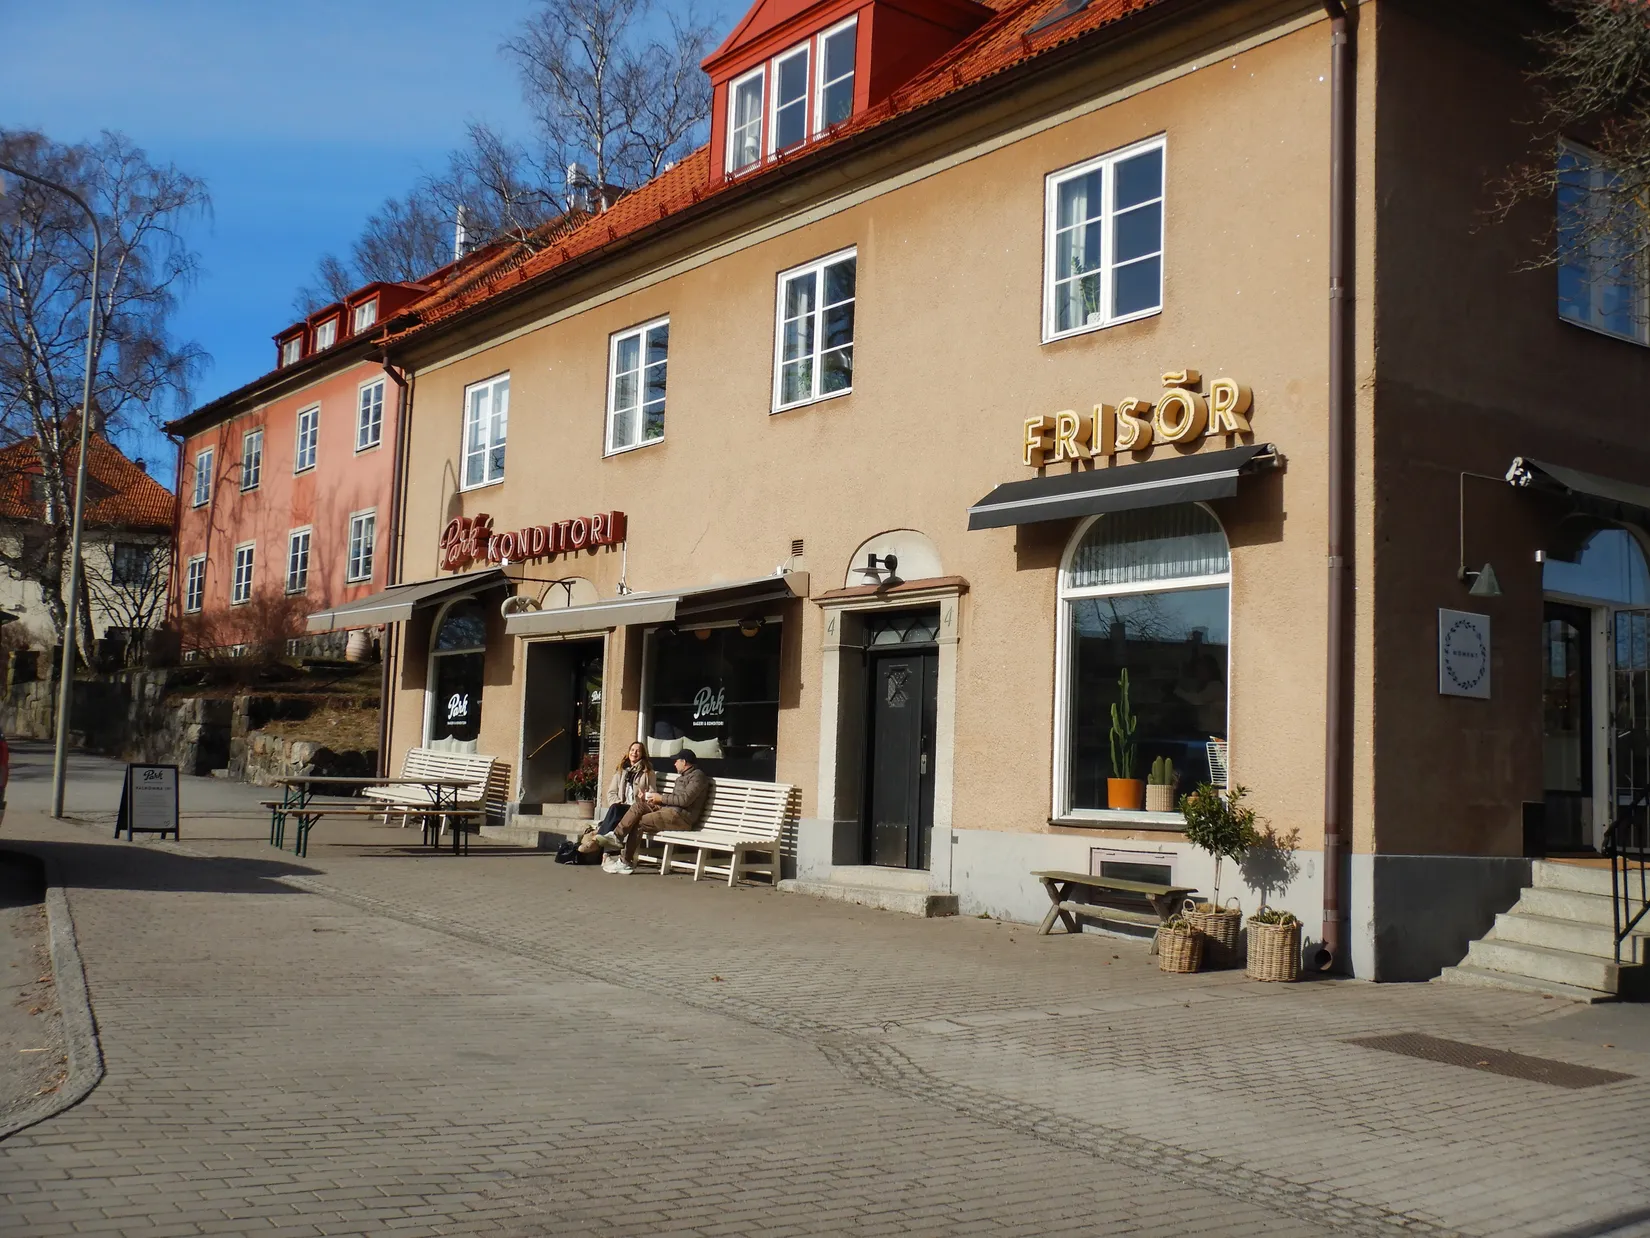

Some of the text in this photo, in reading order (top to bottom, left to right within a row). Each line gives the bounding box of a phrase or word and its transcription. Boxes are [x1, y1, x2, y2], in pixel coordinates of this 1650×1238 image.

[439, 511, 625, 571] Park KONDITORI
[827, 616, 836, 636] 4
[943, 606, 954, 627] 4
[447, 693, 469, 720] Park
[693, 686, 726, 720] Park
[143, 769, 164, 781] Park
